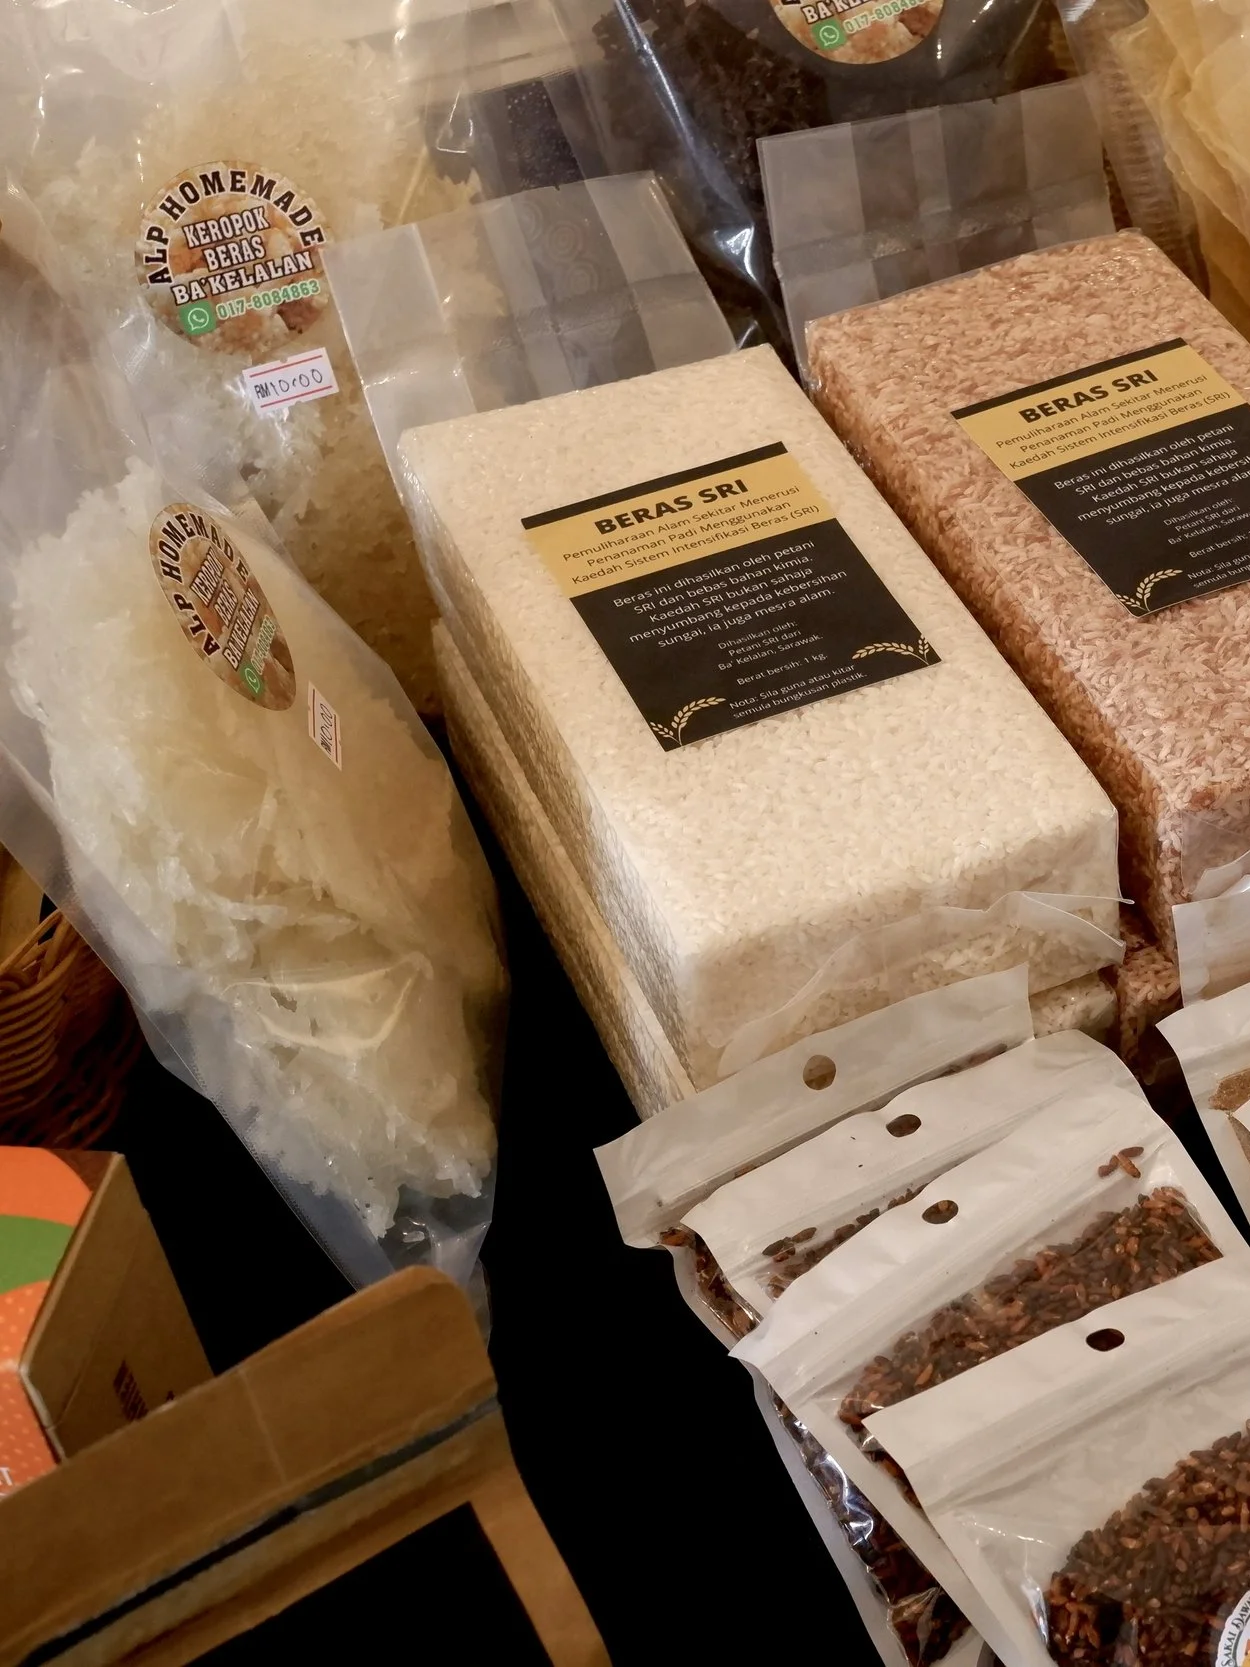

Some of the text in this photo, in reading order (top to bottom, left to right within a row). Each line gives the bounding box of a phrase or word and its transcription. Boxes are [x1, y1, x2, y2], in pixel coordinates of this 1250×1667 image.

[145, 169, 325, 285] ALP HOMEMADE
[182, 206, 271, 248] KEROPOK
[203, 236, 266, 271] BERAS
[171, 251, 314, 306] BA'KELALAN
[216, 280, 320, 320] 017-8084863
[995, 374, 1207, 448] Pemuliharaan Alam Sekitar Menerusi
[1018, 369, 1158, 423] BERAS SRI
[1019, 389, 1202, 452] Penanaman Padi Menggunakan
[1009, 391, 1231, 469] Kaedah Sistem Intensifikasi Beras (SRI)
[1053, 422, 1235, 490] Beras ini dihasilkan oleh petani
[1075, 437, 1238, 496] SRI dan bebas bahan kimia.
[1091, 448, 1238, 503] Kaedah SRI bukan sahaja
[562, 485, 799, 561] Pemuliharaan Alam Sekitar Menerusi
[594, 479, 748, 534] BERAS SRI
[1077, 487, 1163, 522] menyumbang
[1159, 472, 1206, 493] kepada
[1105, 504, 1150, 525] sungai,
[1148, 500, 1163, 510] ia
[1163, 491, 1191, 507] juga
[1191, 478, 1230, 496] mesra
[571, 505, 820, 584] Kaedah Sistem Intensifikasi Beras (SRI)
[586, 502, 791, 566] Penanaman Padi Menggunakan
[158, 513, 249, 656] ALP HOMEMADE
[190, 546, 226, 607] KEROPOK
[613, 539, 815, 608] Beras ini dihasilkan oleh petani
[633, 555, 815, 615] SRI dan bebas bahan kimia.
[649, 567, 813, 623] Kaedah SRI bukan sahaja
[213, 580, 238, 627] BERAS
[629, 570, 848, 643] menyumbang kepada kebersihan
[657, 588, 837, 648] sungai, ia juga mesra alam.
[716, 620, 797, 650] Dihasilkan oleh:
[716, 633, 823, 671] Ba' Kelalan, Sarawak.
[727, 629, 802, 657] Petani SRI dari
[728, 663, 855, 710] Nota: Sila guna atau kitar
[732, 671, 867, 719] semula bungkusan plastik.
[735, 652, 829, 686] Berat bersih: kg.
[1221, 1632, 1236, 1666] SAKAI
